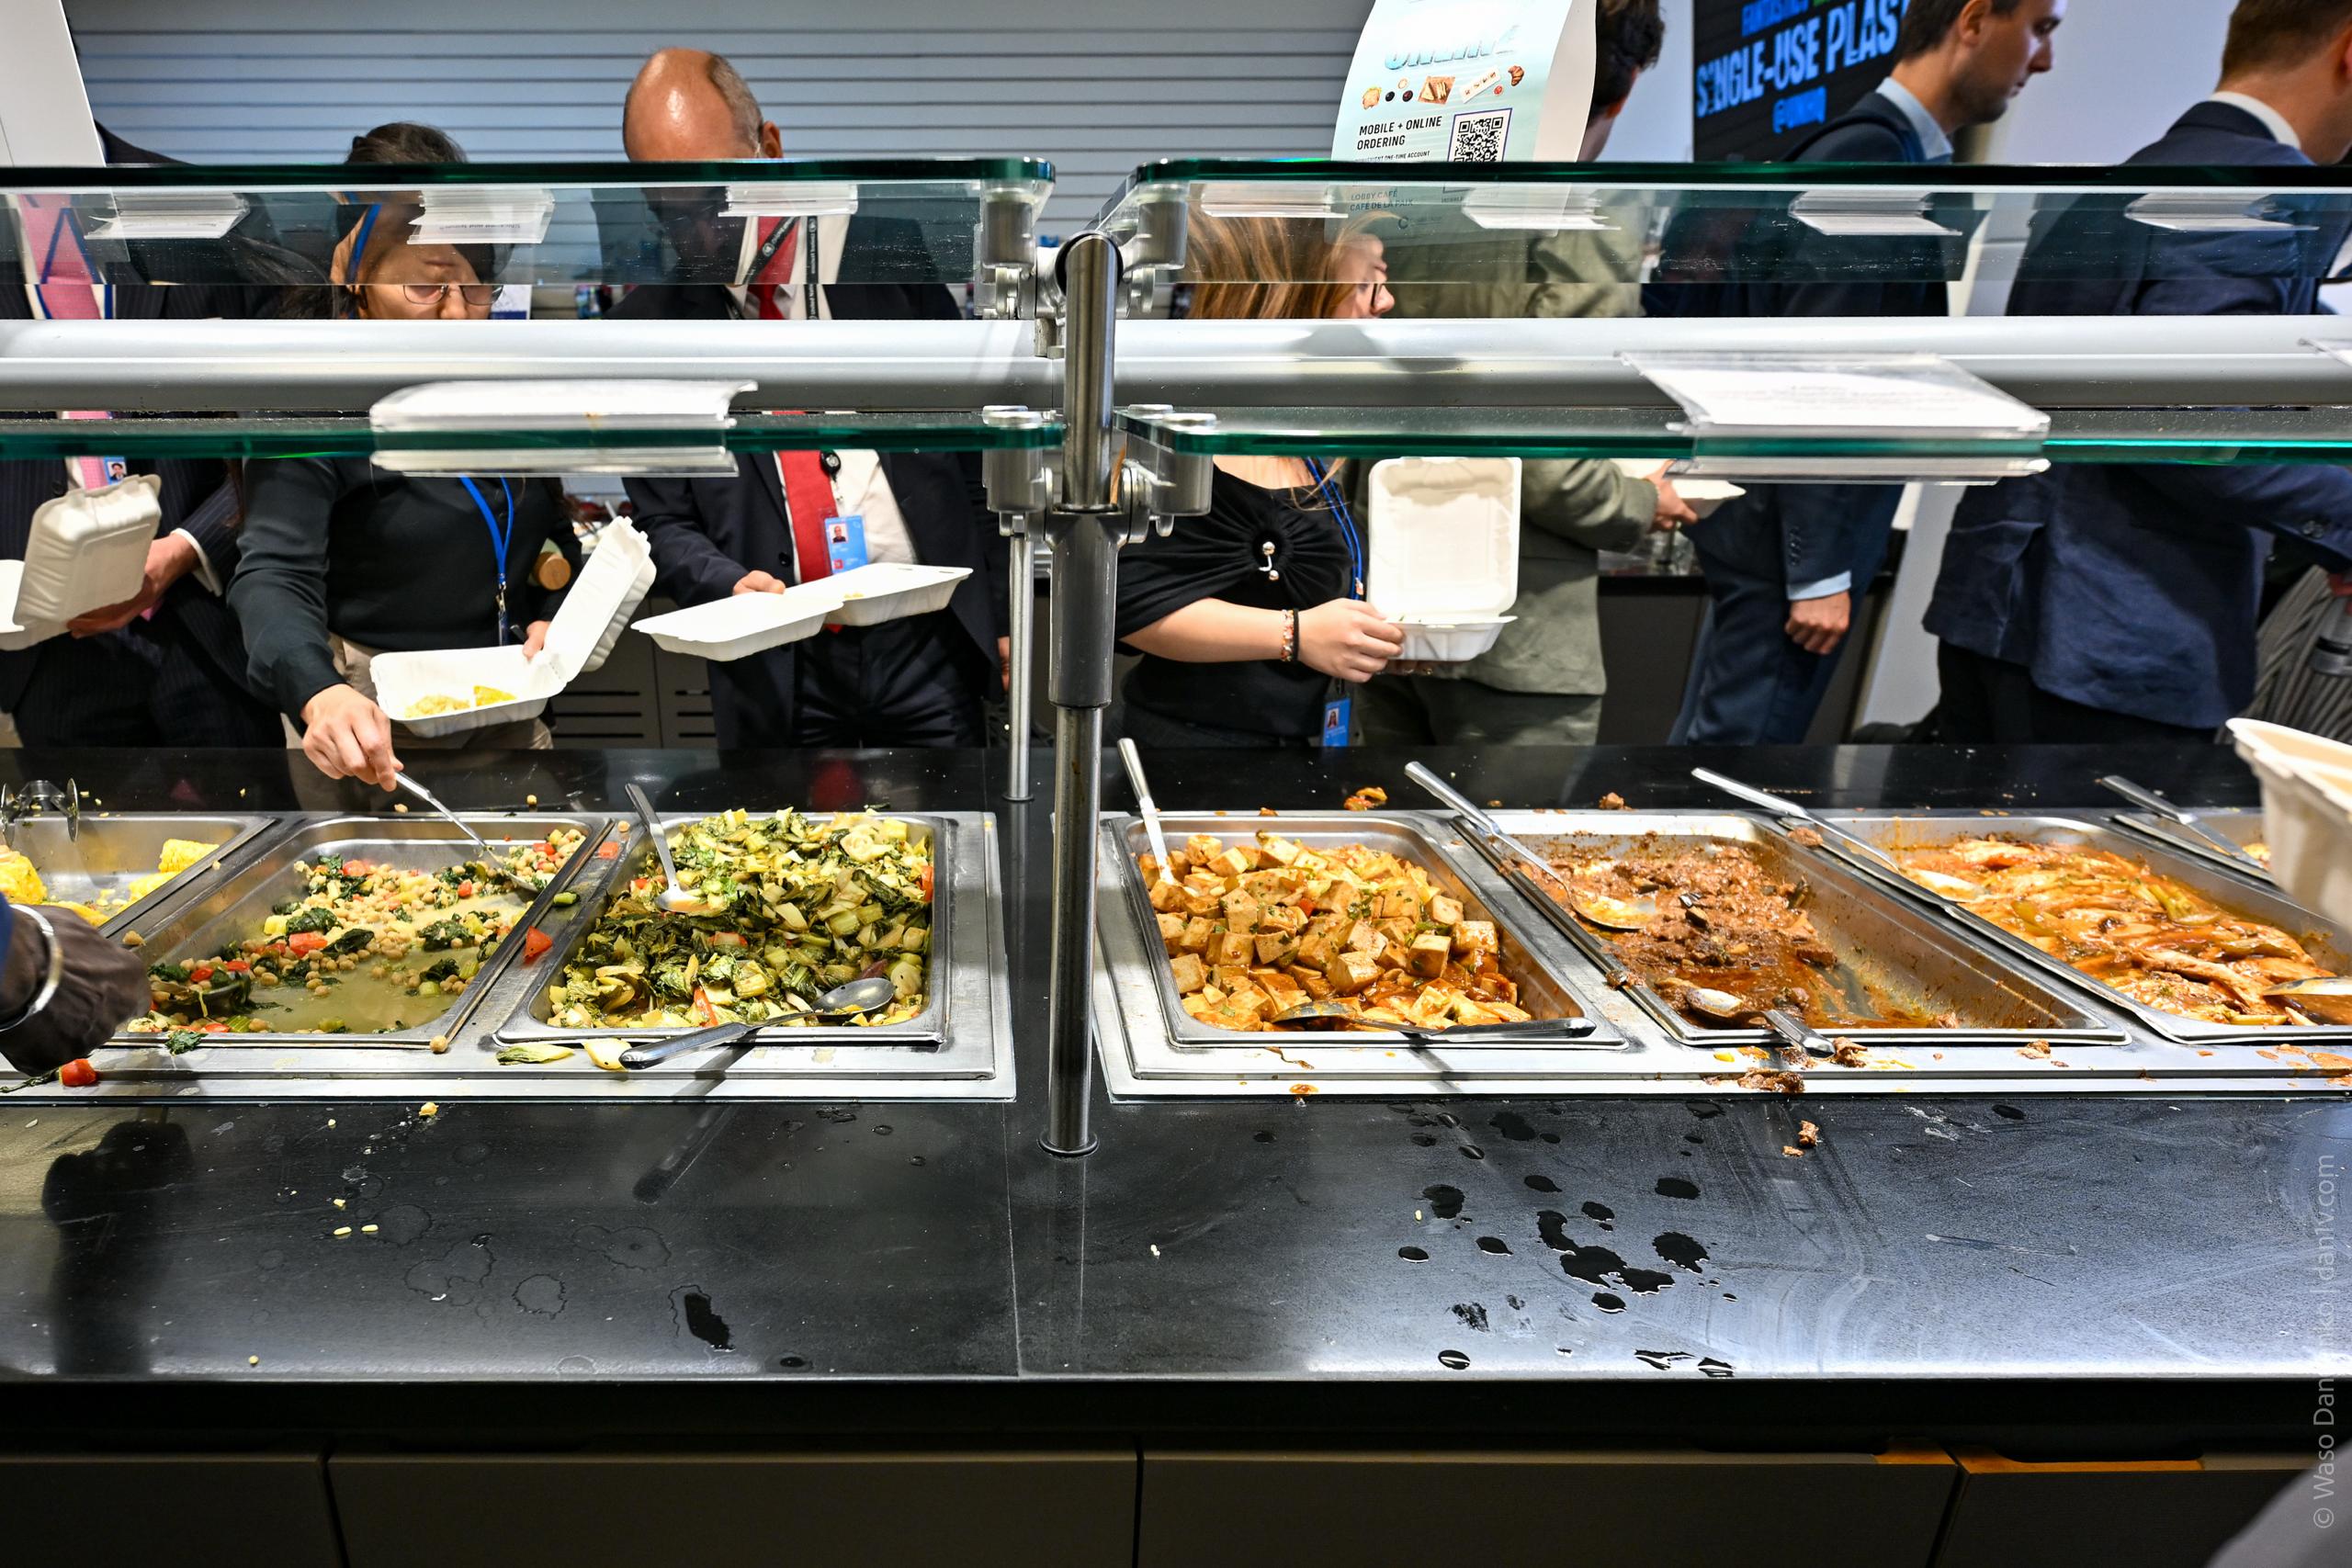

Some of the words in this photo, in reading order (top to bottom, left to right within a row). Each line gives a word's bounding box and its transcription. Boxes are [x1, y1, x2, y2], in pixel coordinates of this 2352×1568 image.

[1697, 17, 1821, 118] SINGLE-USE
[1826, 0, 1910, 73] PLAS
[1359, 121, 1396, 136] MOBILE
[1406, 116, 1442, 129] ONLINE
[1357, 135, 1406, 151] ORDERING
[1351, 192, 1376, 201] LOBBY
